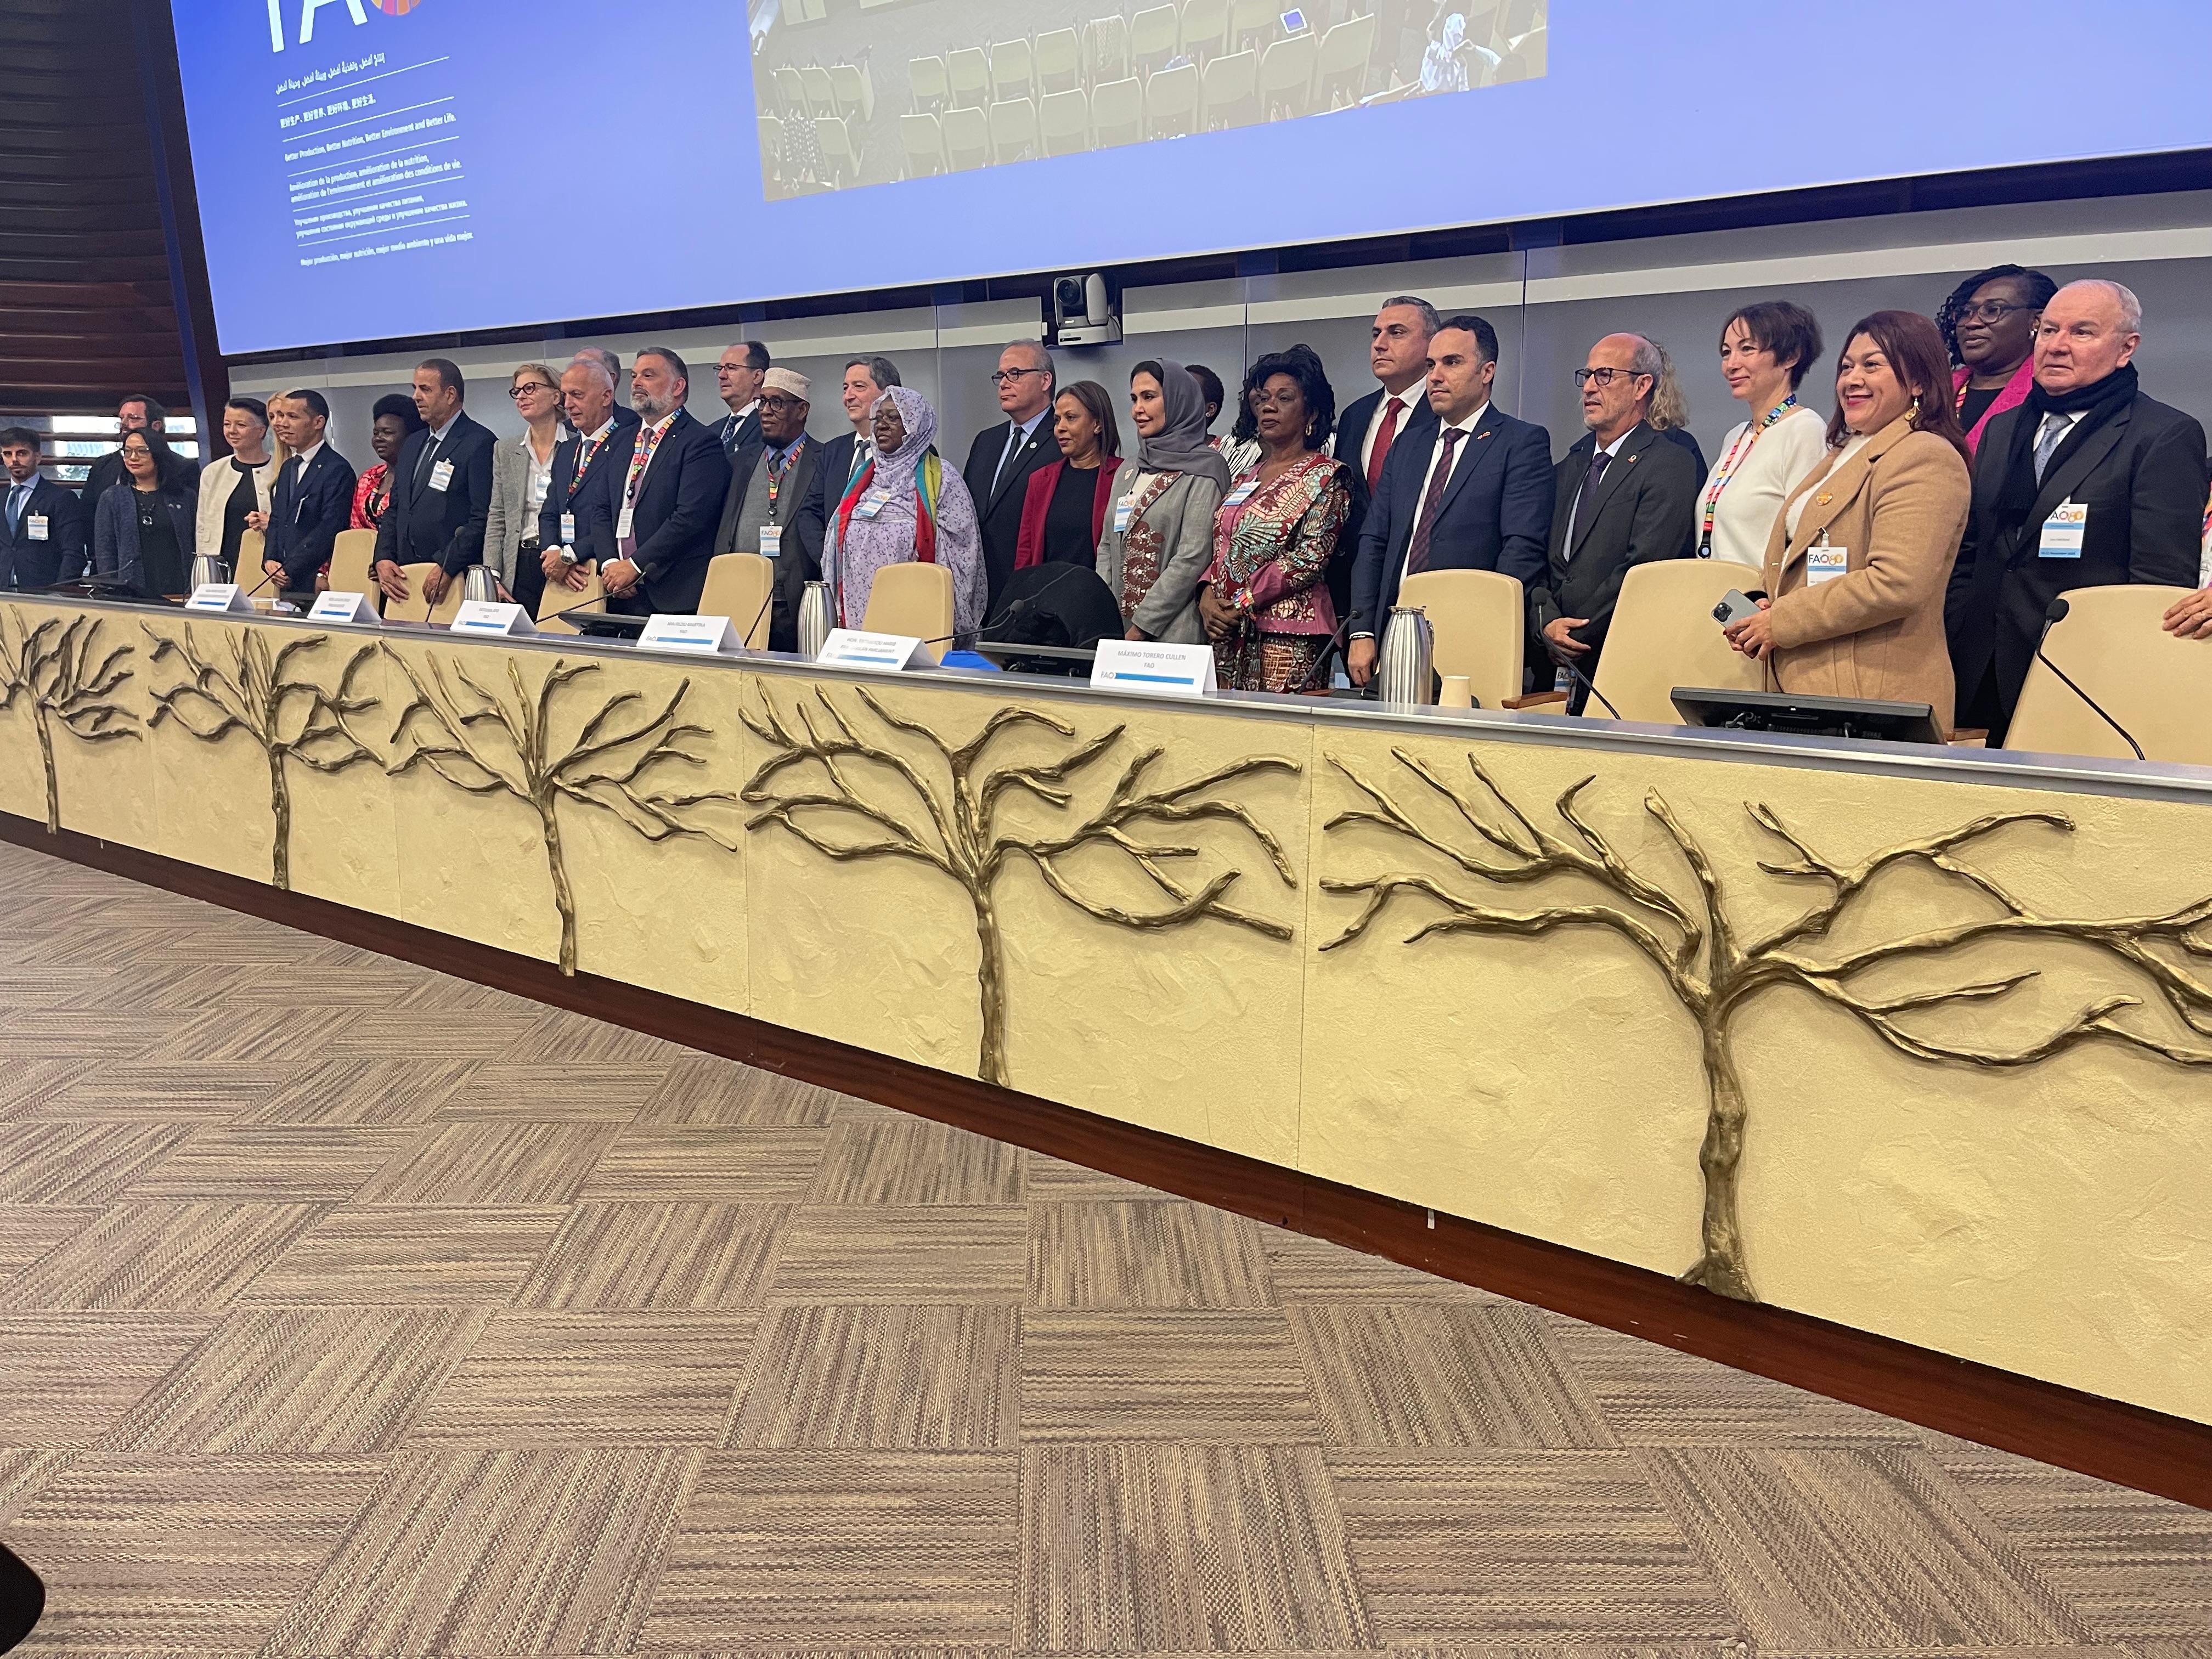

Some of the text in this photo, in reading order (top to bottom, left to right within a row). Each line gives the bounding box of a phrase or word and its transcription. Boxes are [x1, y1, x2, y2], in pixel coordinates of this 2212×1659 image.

[415, 119, 425, 130] and
[426, 117, 443, 127] Better
[444, 113, 456, 123] Life.
[444, 162, 451, 171] de
[1118, 650, 1142, 658] MÁXIMO
